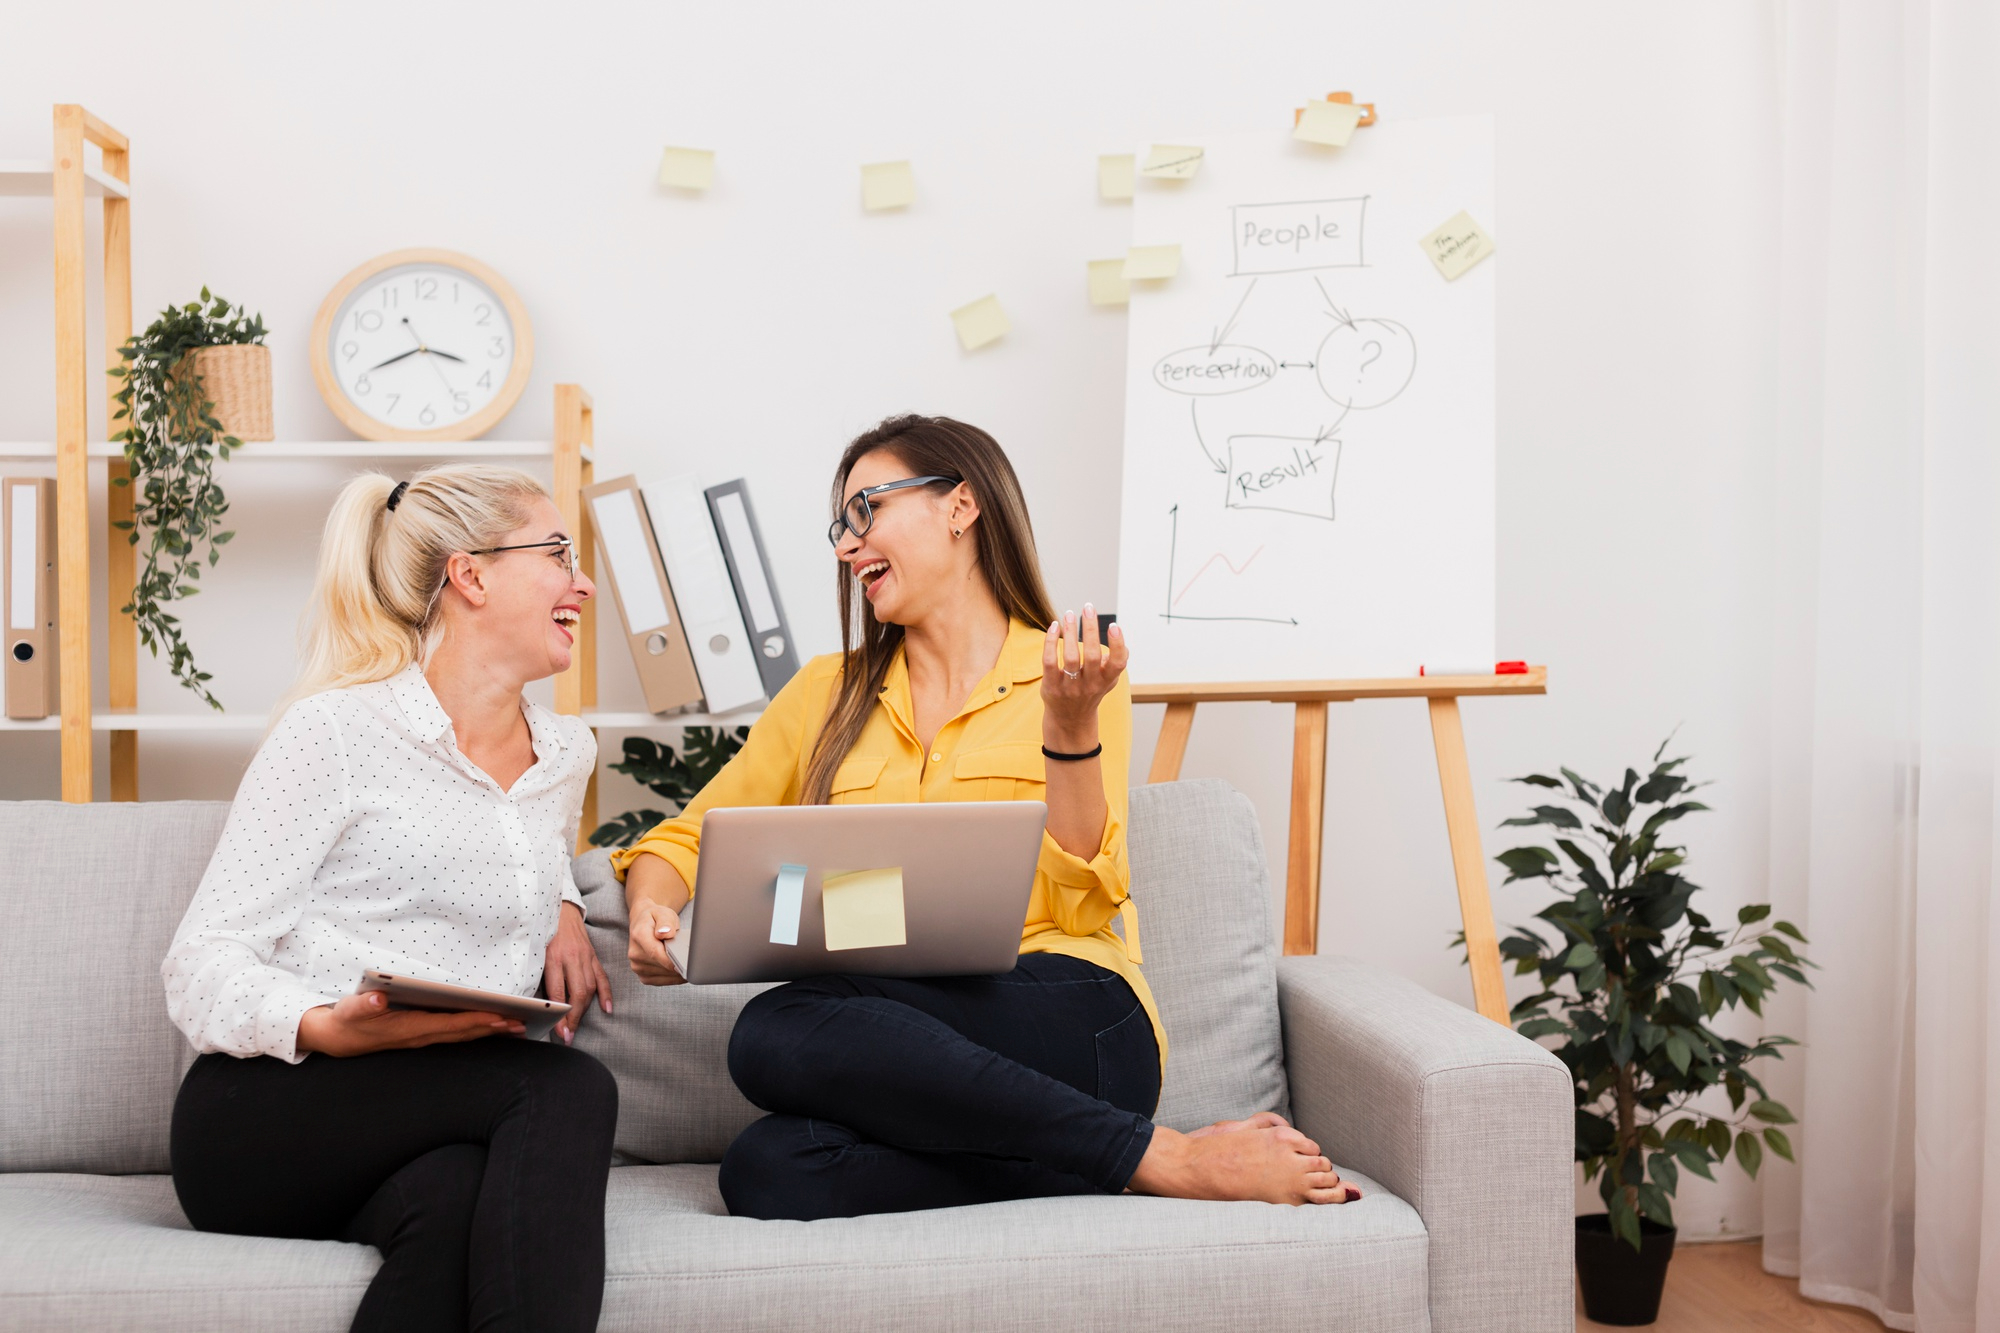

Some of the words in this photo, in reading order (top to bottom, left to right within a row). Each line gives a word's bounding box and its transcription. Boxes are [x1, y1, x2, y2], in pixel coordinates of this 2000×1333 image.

[1243, 213, 1341, 254] People
[383, 288, 398, 308] 11
[415, 278, 438, 300] 12
[454, 283, 459, 303] 1
[354, 310, 383, 332] 10
[475, 304, 491, 325] 2
[342, 341, 359, 362] 9
[488, 337, 504, 359] 3
[1357, 340, 1383, 384] ?
[354, 373, 372, 396] 8
[476, 370, 491, 389] 4
[386, 393, 401, 415] 7
[453, 392, 470, 414] 5
[419, 404, 436, 425] 6
[1236, 446, 1323, 499] Result
